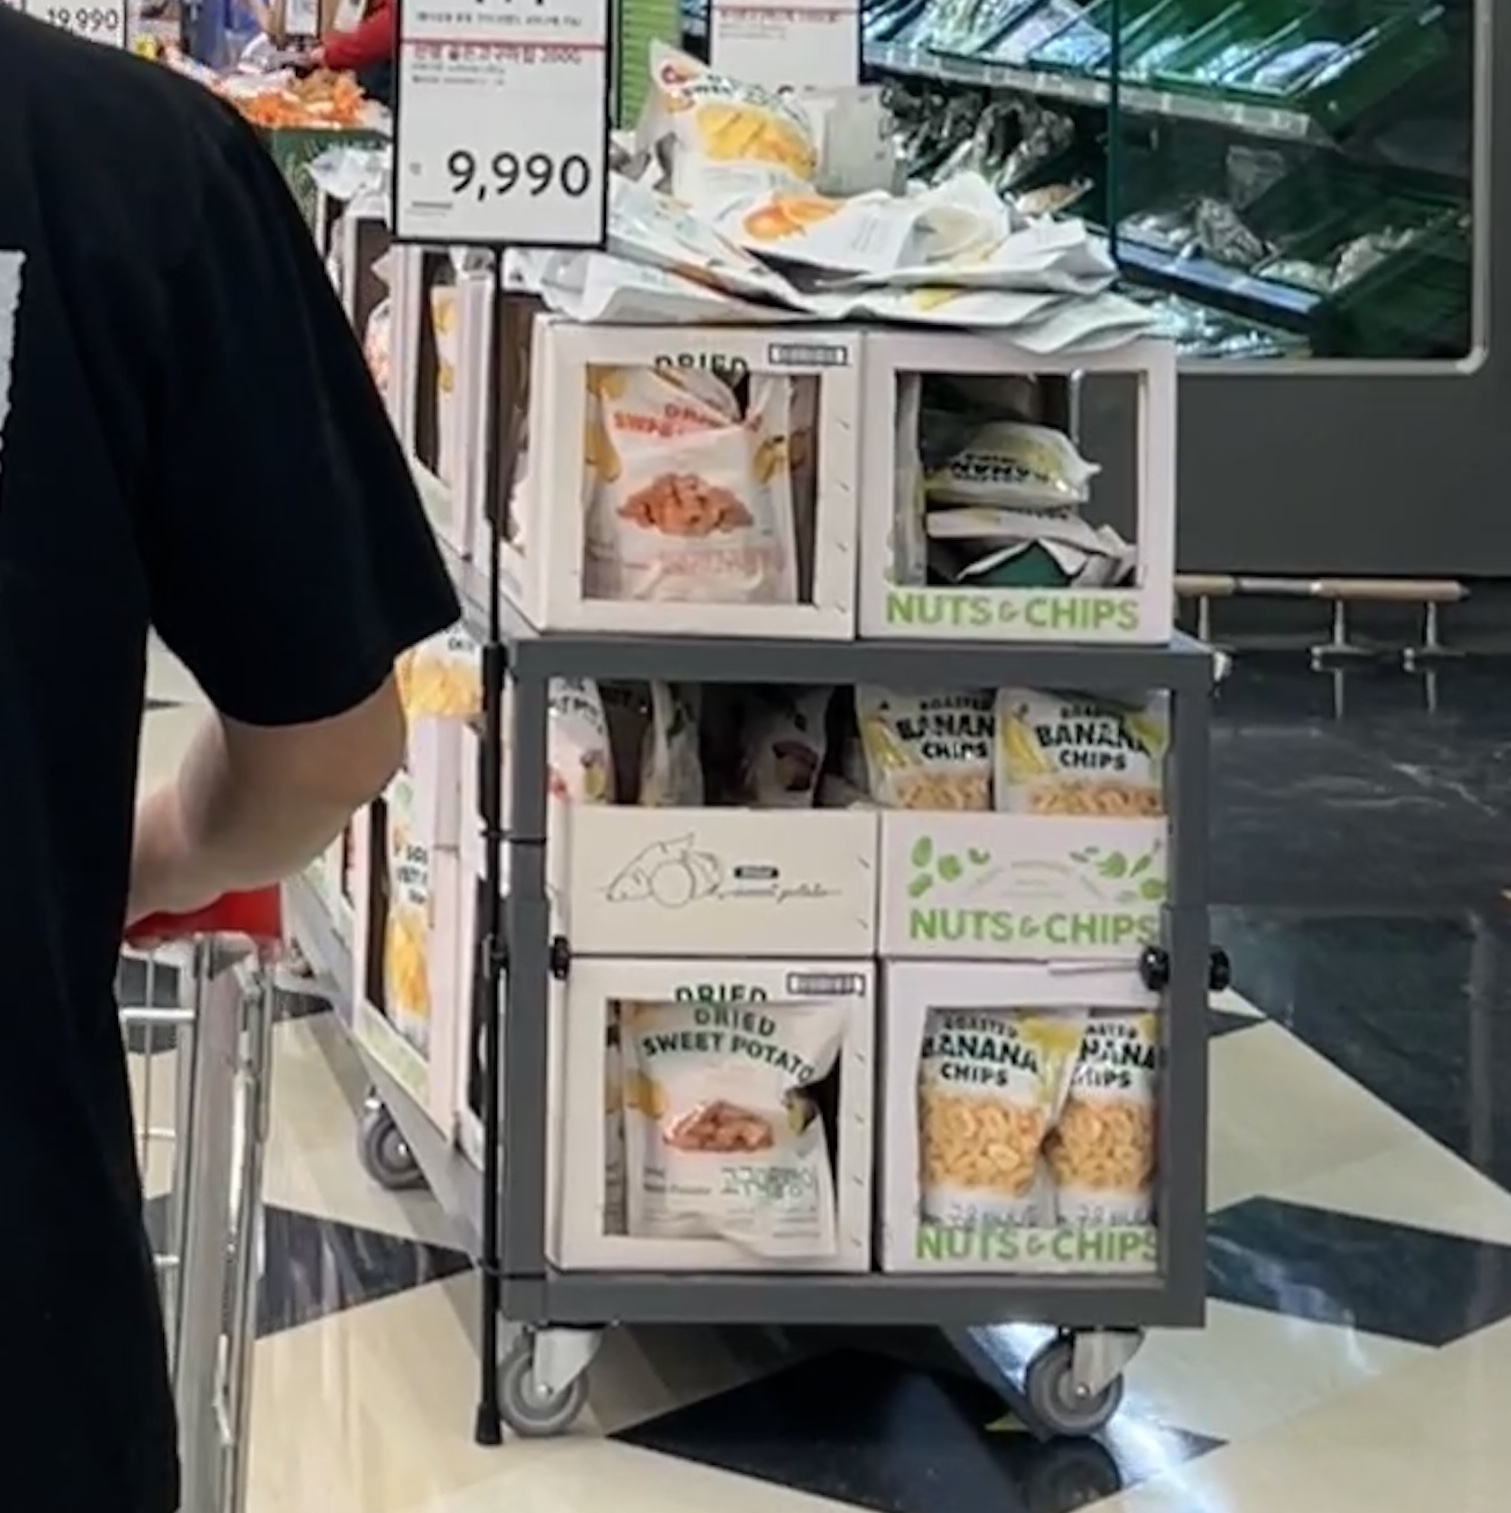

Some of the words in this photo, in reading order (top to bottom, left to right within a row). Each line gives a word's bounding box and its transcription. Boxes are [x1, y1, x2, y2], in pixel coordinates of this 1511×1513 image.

[447, 149, 592, 202] 9,990
[896, 713, 994, 740] BANAN
[1035, 721, 1150, 756] BANAN
[922, 741, 988, 760] CHIPS
[1060, 749, 1127, 771] CHIPS
[694, 1007, 775, 1037] DRIED
[643, 1031, 722, 1057] SWEET
[730, 1036, 816, 1085] POTATO
[941, 1062, 1008, 1087] CHIPS
